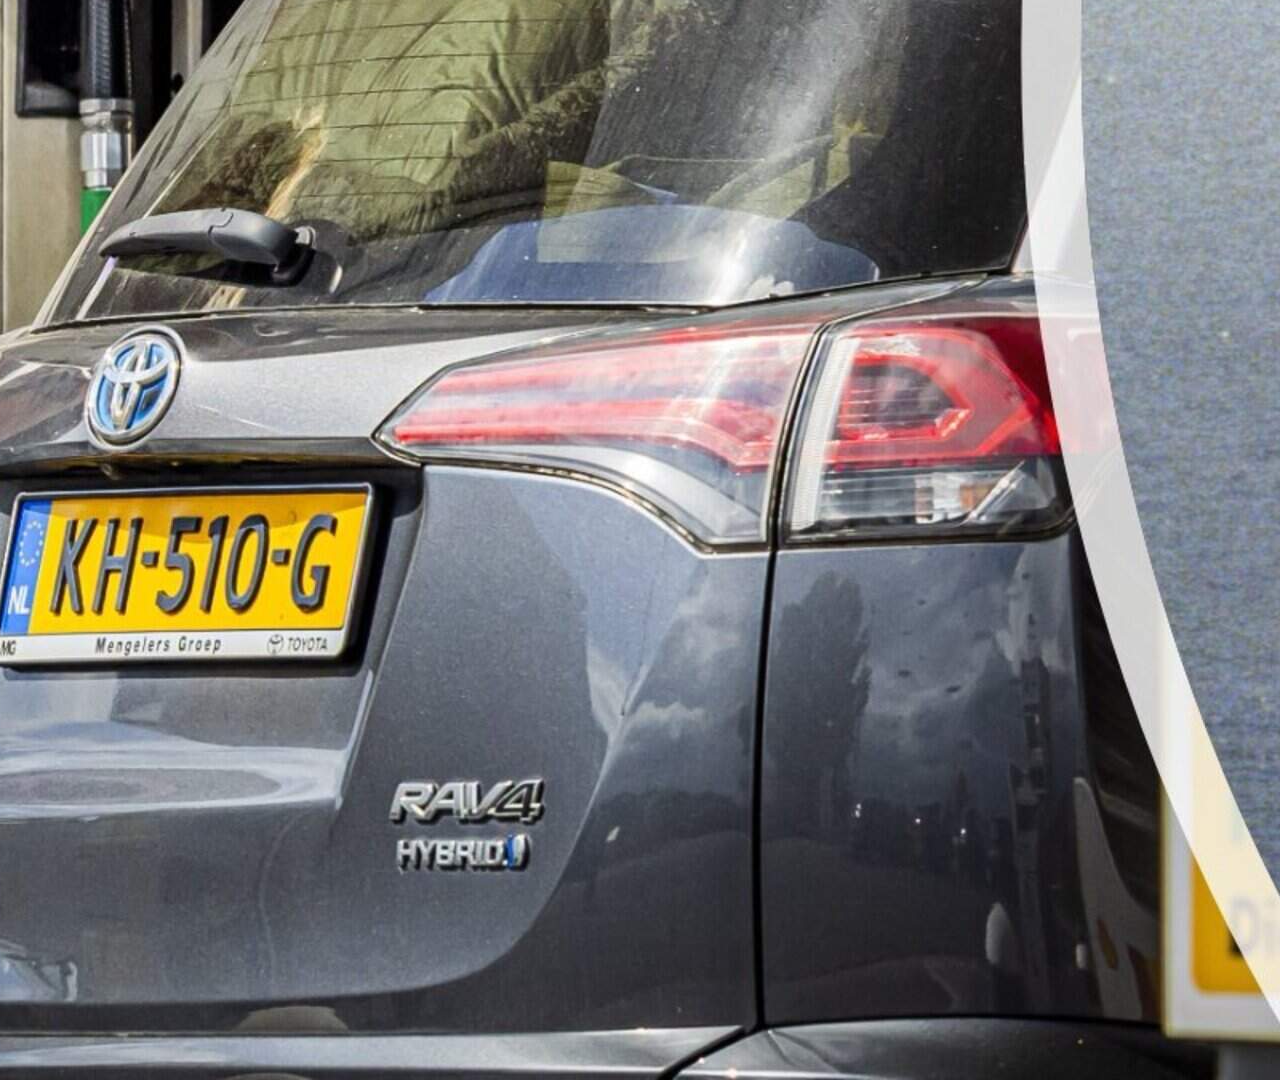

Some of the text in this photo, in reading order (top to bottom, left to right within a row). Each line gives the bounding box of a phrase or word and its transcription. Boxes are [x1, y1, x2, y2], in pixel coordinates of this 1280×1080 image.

[49, 513, 339, 615] KH-510-G
[6, 585, 31, 615] NL
[94, 636, 170, 655] Mengelers
[286, 636, 328, 652] TOYOTA
[389, 777, 545, 824] RAV4
[396, 838, 504, 871] HYBRID
